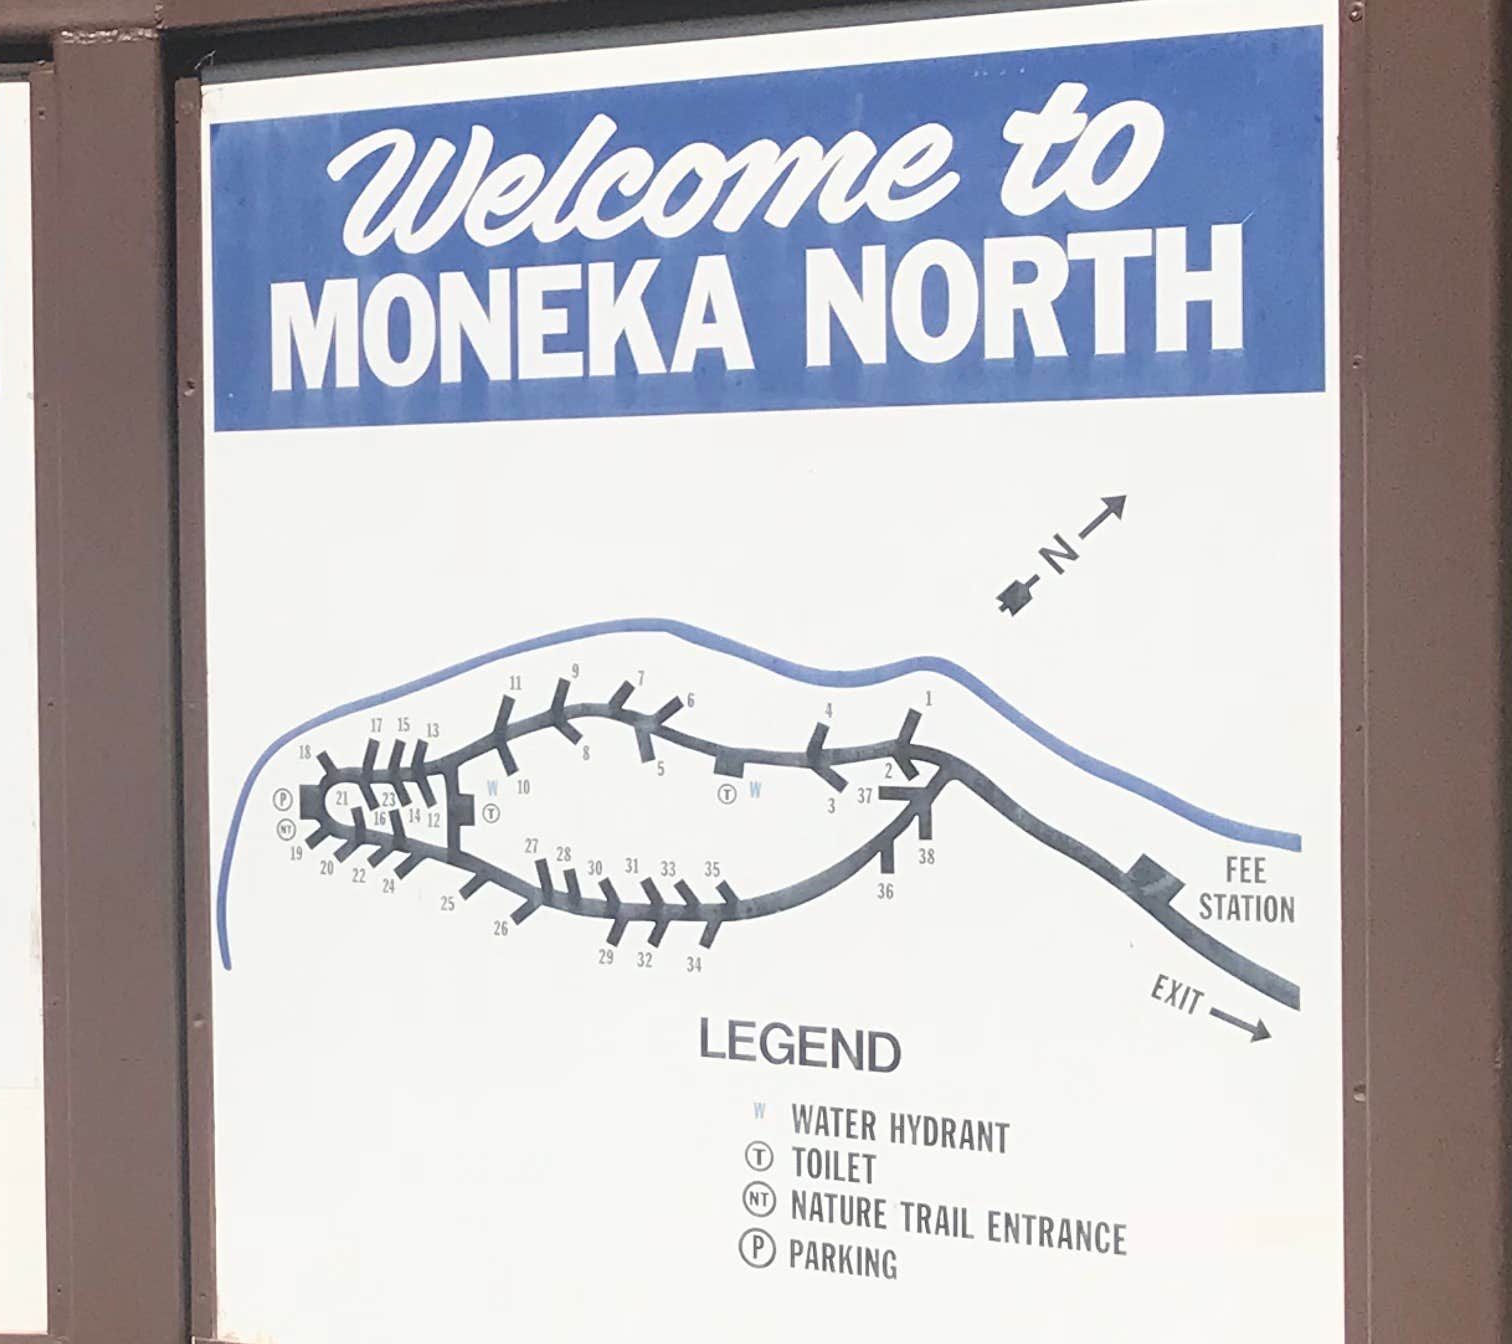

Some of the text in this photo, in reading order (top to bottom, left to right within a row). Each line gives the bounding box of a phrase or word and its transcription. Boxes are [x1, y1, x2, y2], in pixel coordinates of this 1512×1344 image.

[326, 82, 1165, 257] Welcome to
[270, 223, 1243, 392] MONEKA NORTH
[1037, 532, 1080, 576] N
[509, 674, 523, 691] 11
[370, 717, 384, 734] 17
[397, 716, 411, 733] 15
[426, 722, 440, 739] 13
[517, 778, 531, 795] 10
[857, 786, 873, 805] 37
[335, 789, 349, 807] 21
[382, 791, 396, 807] 23
[374, 811, 386, 826] 16
[408, 807, 422, 824] 14
[427, 812, 441, 829] 12
[290, 845, 303, 861] 19
[524, 837, 539, 854] 27
[555, 845, 572, 863] 28
[624, 856, 639, 874] 31
[918, 847, 936, 865] 38
[319, 859, 335, 876] 20
[351, 867, 367, 884] 22
[587, 859, 603, 876] 30
[660, 859, 677, 878] 33
[704, 860, 721, 878] 35
[1226, 855, 1267, 884] FEE
[382, 877, 396, 894] 24
[877, 882, 894, 900] 36
[440, 895, 456, 912] 25
[1199, 892, 1295, 924] STATION
[493, 919, 509, 937] 26
[598, 948, 614, 965] 29
[636, 951, 653, 969] 32
[686, 955, 703, 973] 34
[1150, 973, 1206, 1015] EXIT
[700, 1016, 902, 1074] LEGEND
[791, 1103, 1011, 1154] WATER HYDRANT
[791, 1146, 877, 1185] TOILET
[791, 1189, 1127, 1256] NATURE TRAIL ENTRANCE
[789, 1238, 897, 1280] PARKING
